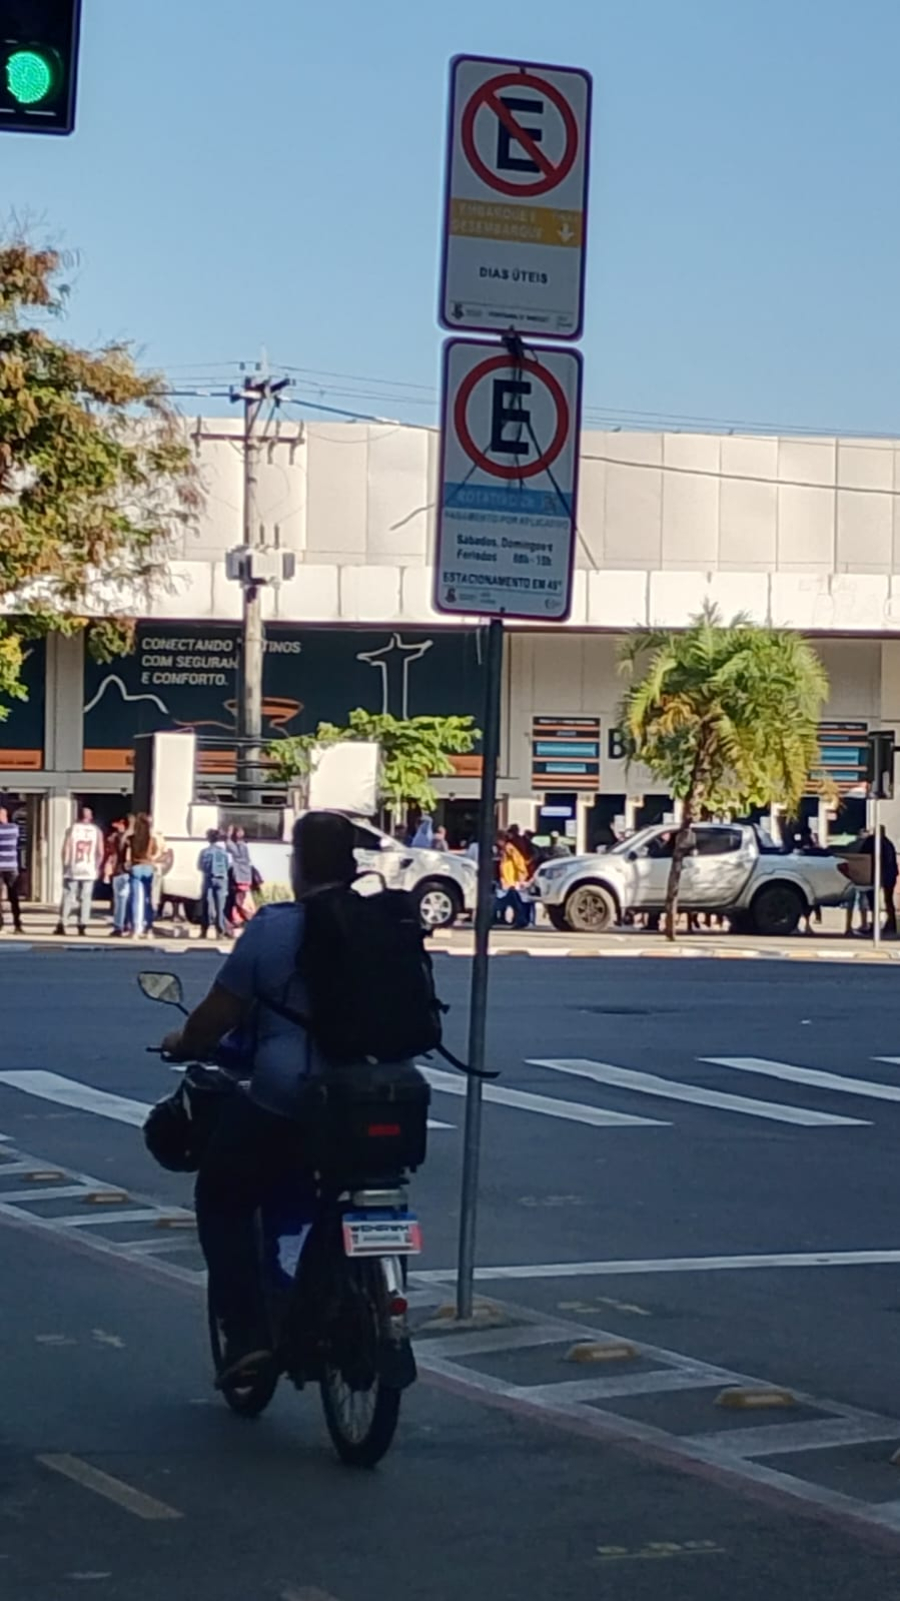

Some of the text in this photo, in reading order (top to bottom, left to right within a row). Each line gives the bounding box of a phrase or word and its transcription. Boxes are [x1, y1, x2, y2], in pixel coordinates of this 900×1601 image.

[479, 266, 548, 284] DIAS ÚTEIS
[491, 378, 532, 455] E
[457, 549, 498, 562] Feriados
[443, 571, 531, 588] ESTACIONAMENTO
[532, 579, 546, 589] EM
[141, 637, 233, 652] CONECTANDO
[141, 655, 173, 667] COM
[141, 672, 228, 685] E CONFORTO.
